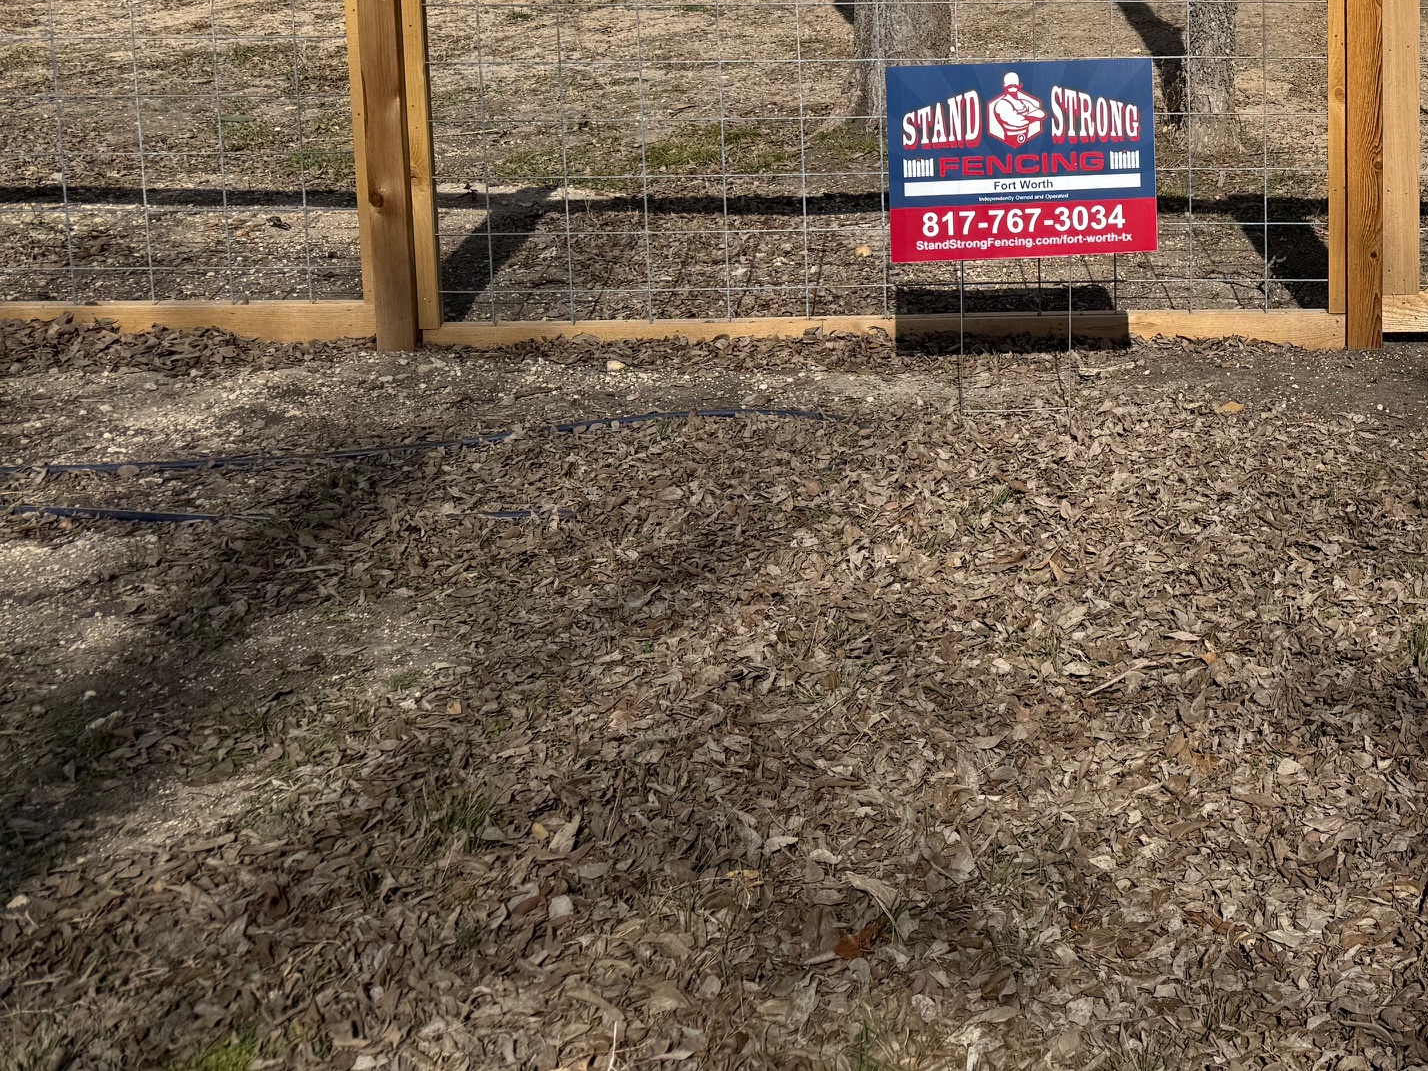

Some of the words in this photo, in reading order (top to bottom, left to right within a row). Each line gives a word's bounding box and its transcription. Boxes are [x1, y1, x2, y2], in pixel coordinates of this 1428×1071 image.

[902, 90, 981, 148] STAND
[1051, 86, 1140, 142] STRONG
[939, 151, 1105, 178] FENCING
[994, 181, 1017, 191] Fort
[1020, 179, 1054, 190] Worth
[922, 204, 1126, 238] 817-767-3034
[916, 232, 1133, 251] StandStrongFencing.com/fort-worth-tx
